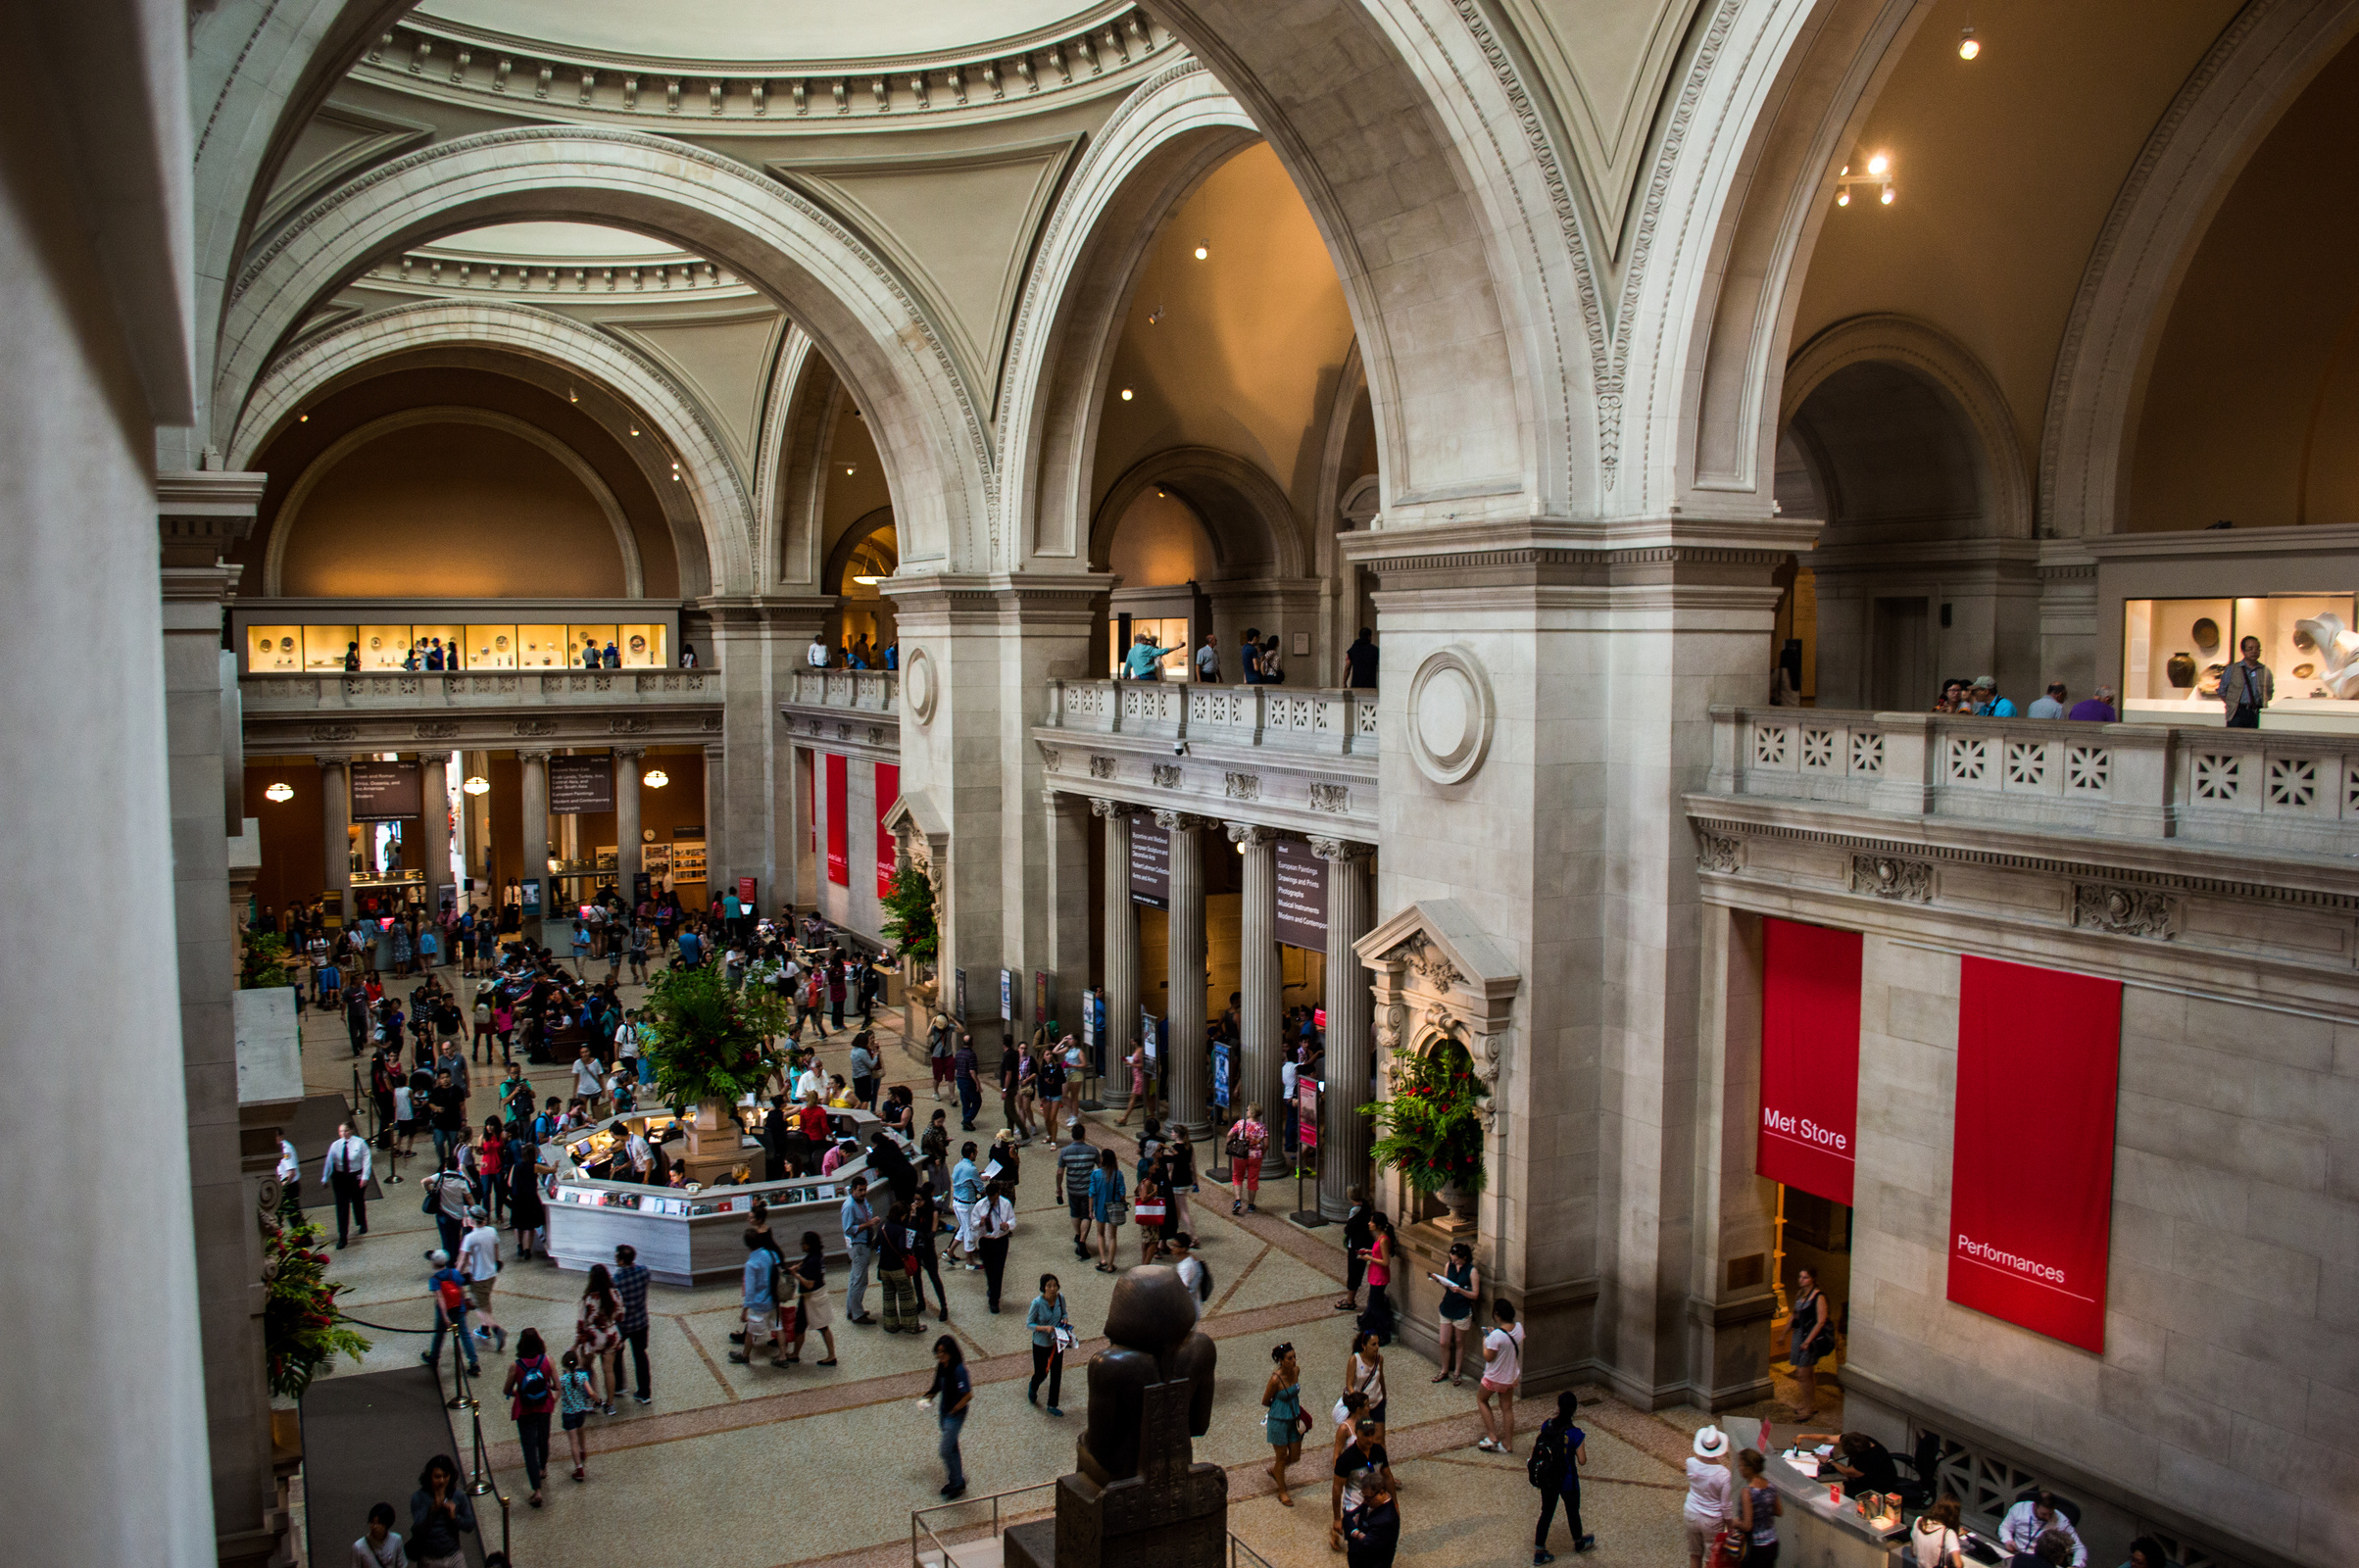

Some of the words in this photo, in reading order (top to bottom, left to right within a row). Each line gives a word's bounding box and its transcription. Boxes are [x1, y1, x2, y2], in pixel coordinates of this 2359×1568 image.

[1278, 861, 1297, 870] European
[1298, 865, 1318, 876] Paintings
[1278, 874, 1297, 885] Drawings
[1306, 879, 1319, 888] Prints
[1278, 887, 1304, 898] Photographs
[1278, 899, 1293, 908] Musical
[1295, 903, 1319, 914] Instruments
[1278, 912, 1294, 921] Modern
[1764, 1107, 1797, 1135] Met
[1801, 1119, 1847, 1150] Store
[1957, 1234, 2066, 1284] Performances
